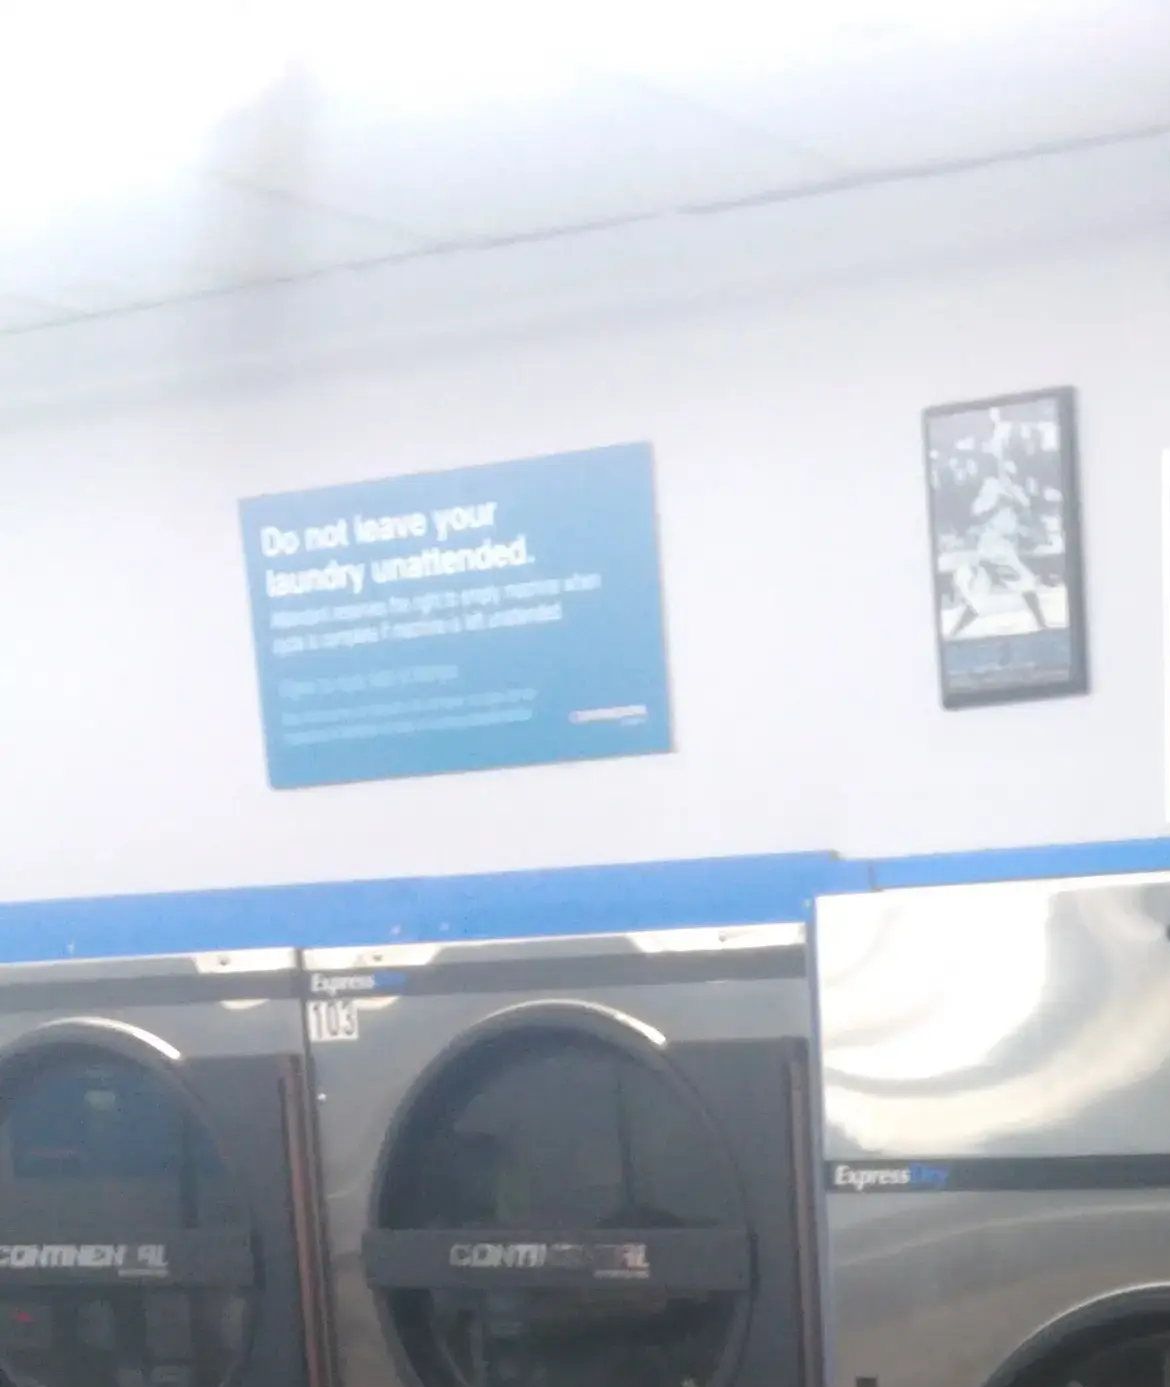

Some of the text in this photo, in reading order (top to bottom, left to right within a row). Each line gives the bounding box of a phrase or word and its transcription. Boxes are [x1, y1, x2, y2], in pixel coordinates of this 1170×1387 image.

[261, 501, 497, 557] Do not leave your
[266, 533, 535, 597] laundry unattended.
[312, 1001, 357, 1038] 103
